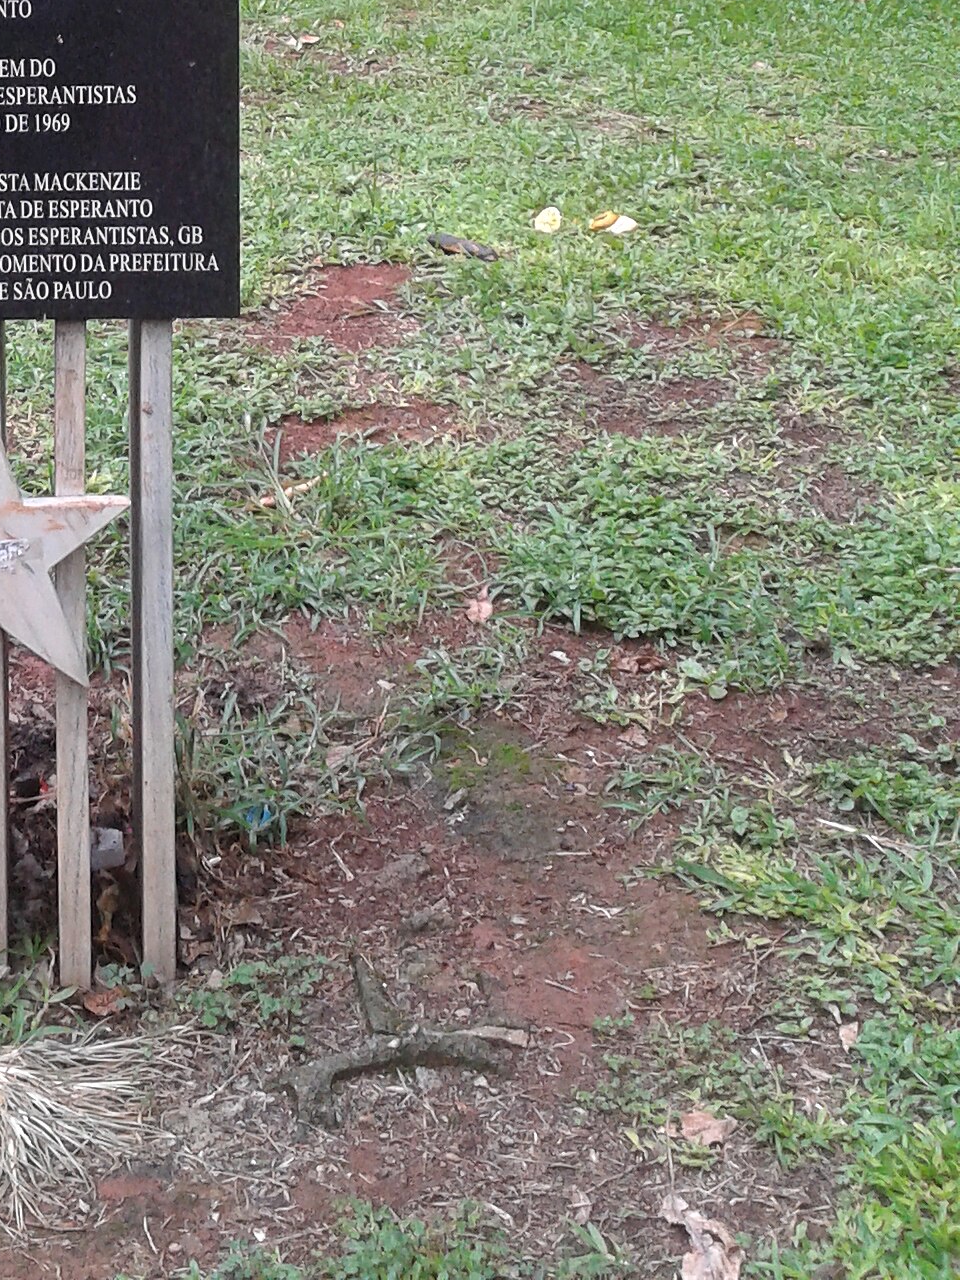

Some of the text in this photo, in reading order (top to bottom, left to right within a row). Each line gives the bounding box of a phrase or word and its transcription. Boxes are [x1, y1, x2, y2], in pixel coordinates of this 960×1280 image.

[29, 58, 56, 78] DO
[4, 113, 30, 133] DE
[34, 112, 71, 133] 1969
[33, 171, 141, 192] MACKENZIE
[19, 199, 45, 219] DE
[47, 198, 153, 219] ESPERANTO
[27, 225, 175, 247] ESPERANTISTAS,
[177, 225, 203, 245] GB
[80, 253, 107, 273] DA
[108, 252, 220, 273] PREFEITURA
[13, 277, 50, 301] SÃO
[52, 280, 112, 300] PAULO
